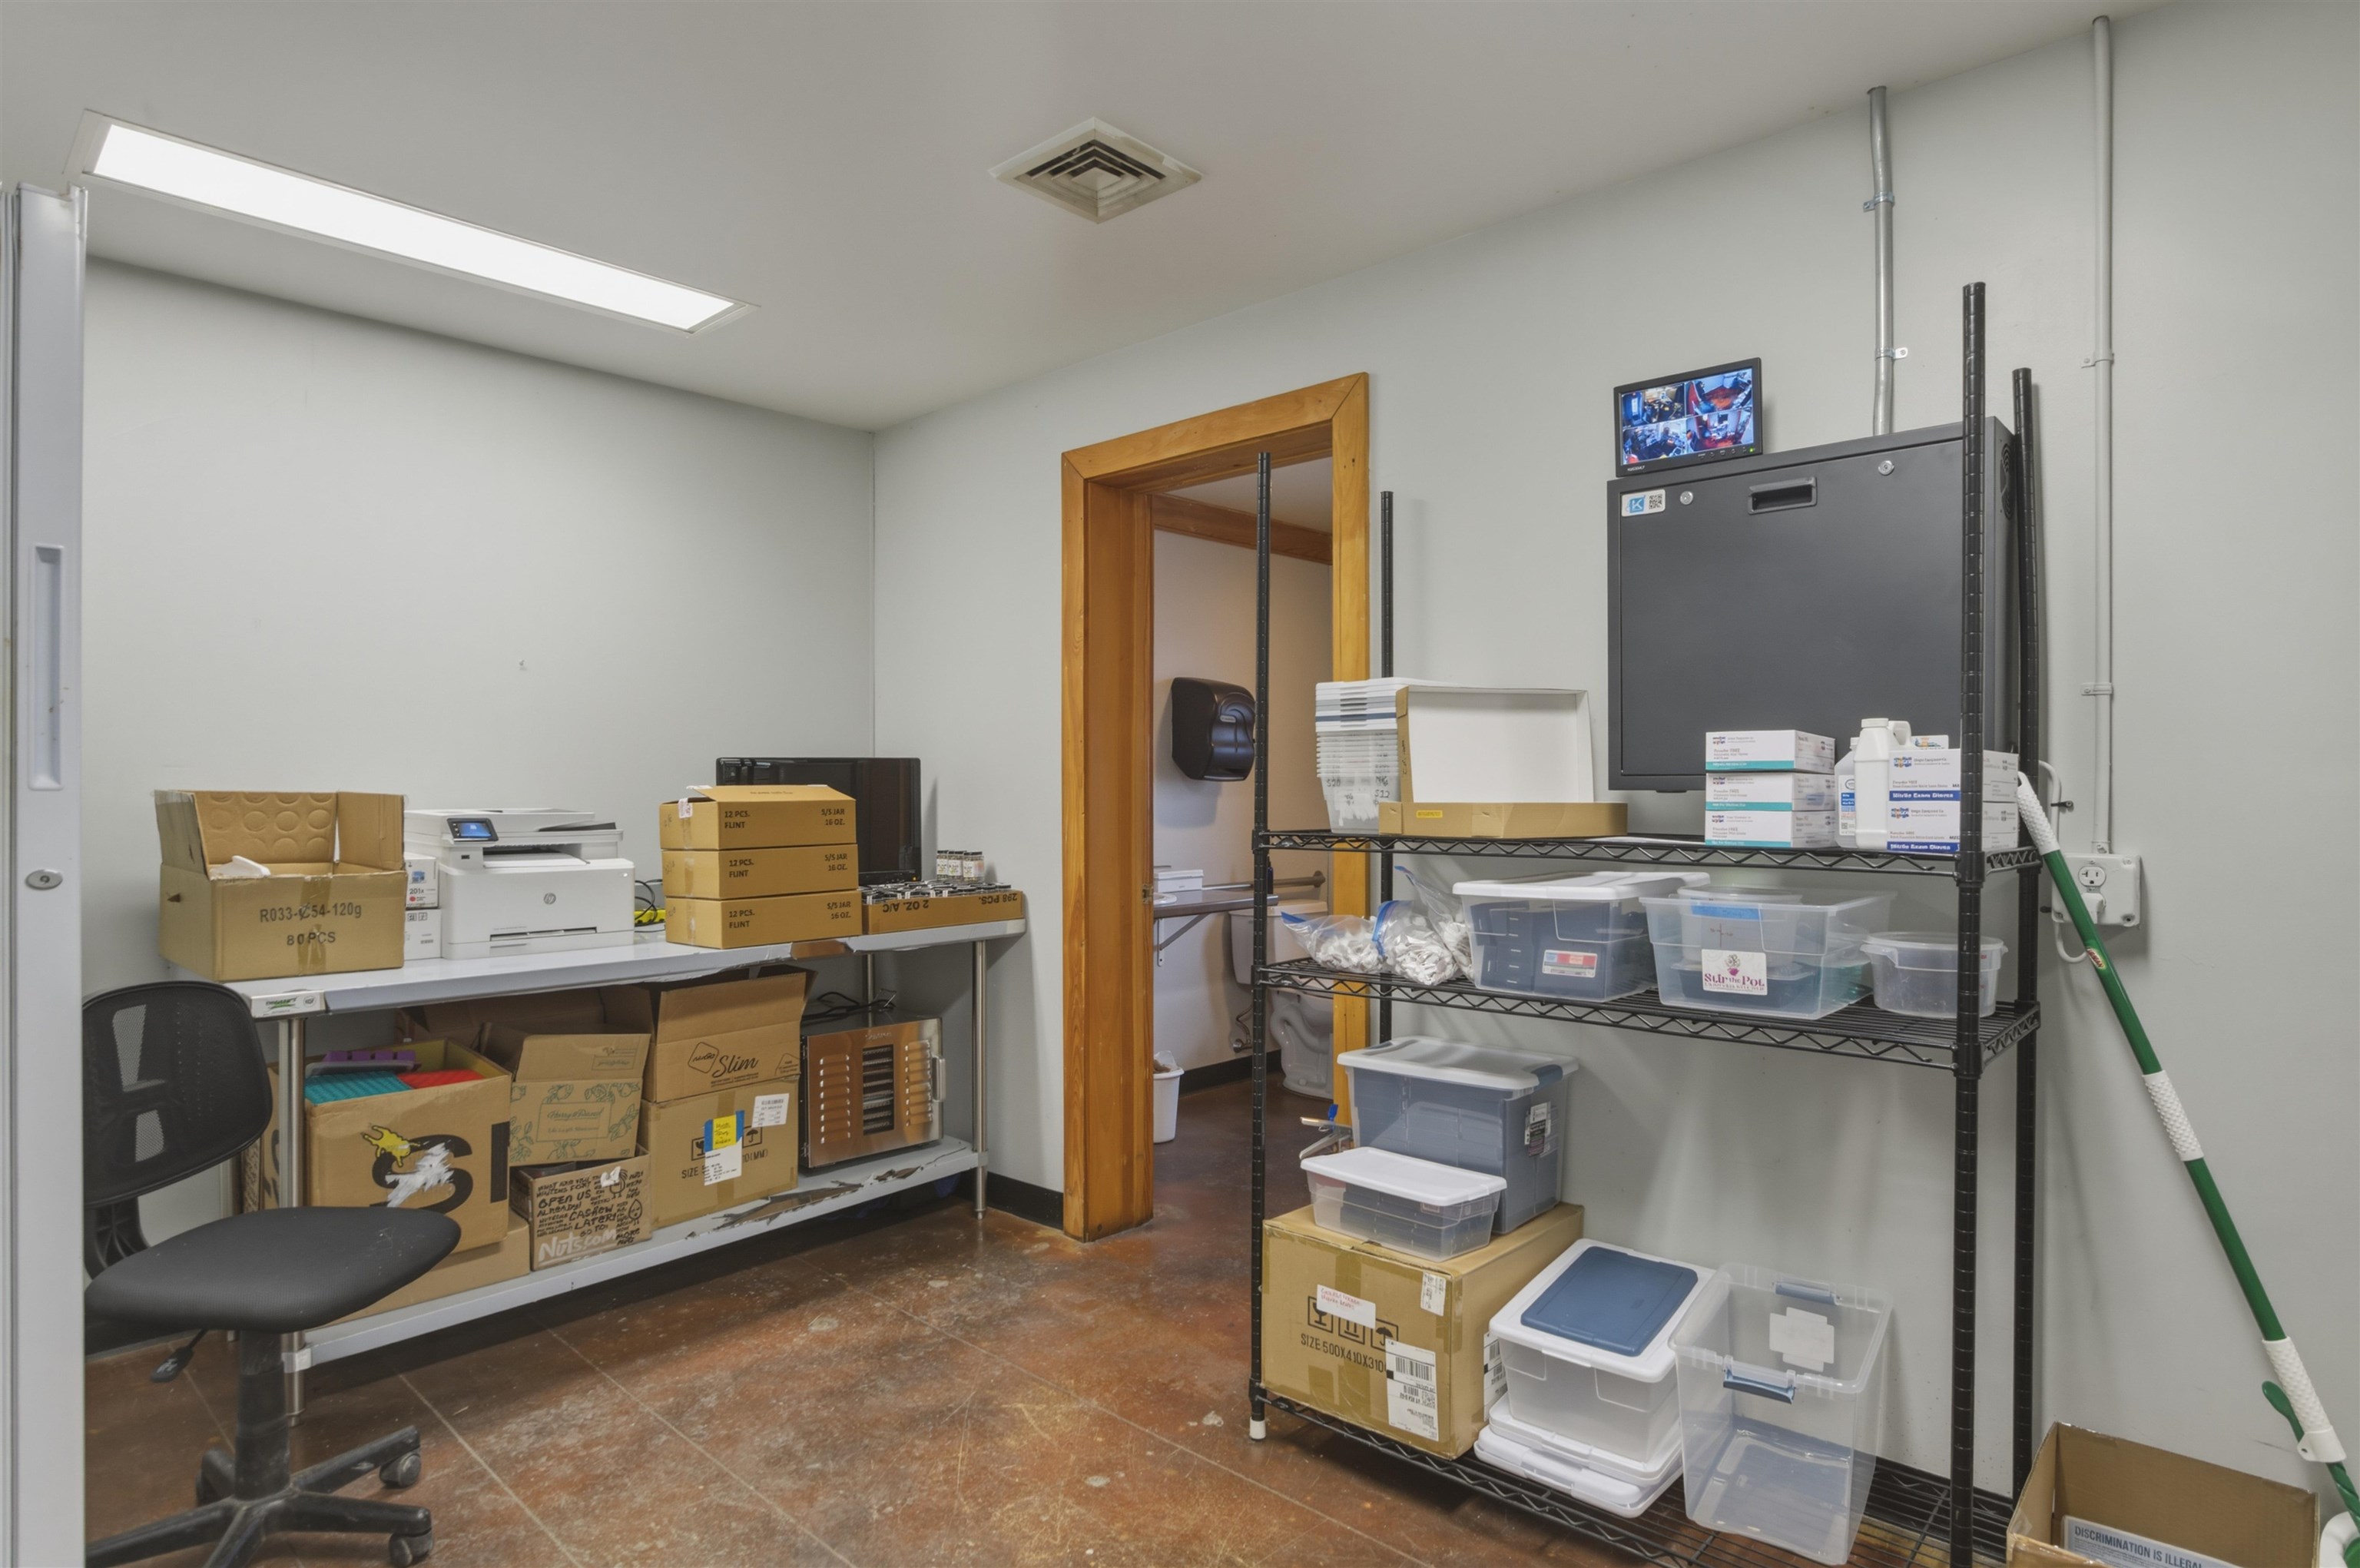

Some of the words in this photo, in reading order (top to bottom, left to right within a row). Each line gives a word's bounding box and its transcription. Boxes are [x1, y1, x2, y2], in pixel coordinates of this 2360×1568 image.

[729, 870, 749, 878] FLINT
[923, 899, 930, 909] 2
[729, 920, 750, 929] FLINT
[1742, 976, 1765, 987] Pot
[711, 1055, 759, 1078] Slim
[577, 1189, 592, 1201] US
[2074, 1525, 2151, 1559] DISCRIMINATION
[2153, 1549, 2163, 1562] IS
